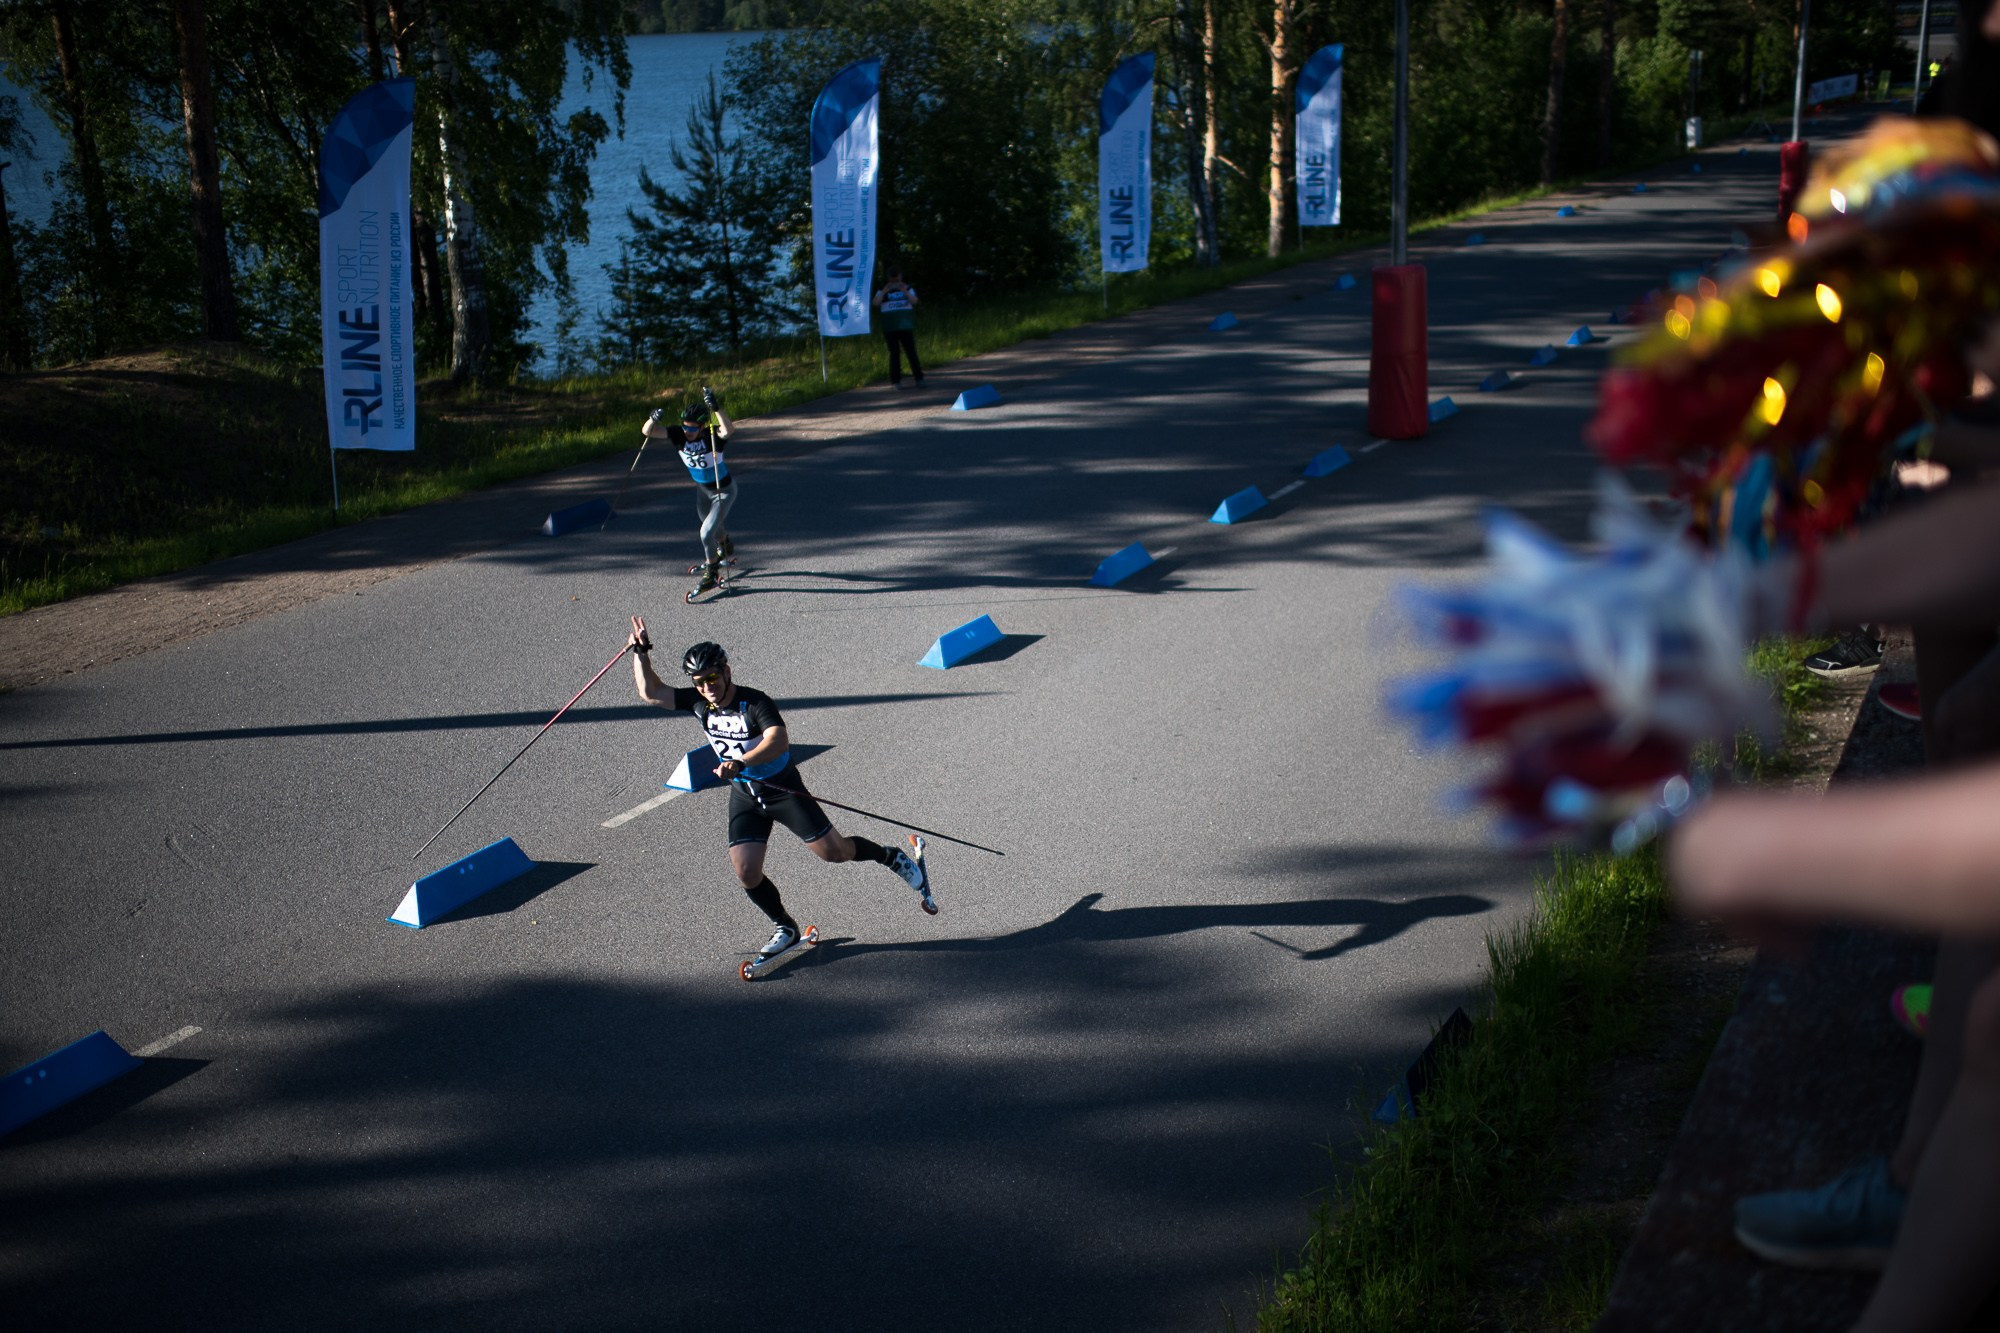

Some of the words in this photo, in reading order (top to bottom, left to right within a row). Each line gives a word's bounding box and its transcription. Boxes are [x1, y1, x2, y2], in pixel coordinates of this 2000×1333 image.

[823, 184, 839, 229] SPORT
[839, 158, 855, 228] NUTRITION
[1306, 154, 1325, 218] RLINE
[390, 212, 401, 248] РОССИИ
[1110, 185, 1134, 264] RLINE
[337, 245, 358, 304] SPORT
[359, 210, 380, 304] NUTRITION
[390, 262, 402, 303] ПИТАНИЕ
[391, 250, 402, 261] ИЗ
[825, 228, 855, 327] RLINE
[390, 306, 402, 362] СПОРТИВНОЕ
[338, 304, 383, 436] RLINE
[391, 364, 404, 430] КАЧЕСТВЕННОЕ
[686, 454, 708, 469] 36
[714, 740, 746, 759] 21
[731, 731, 749, 739] wear
